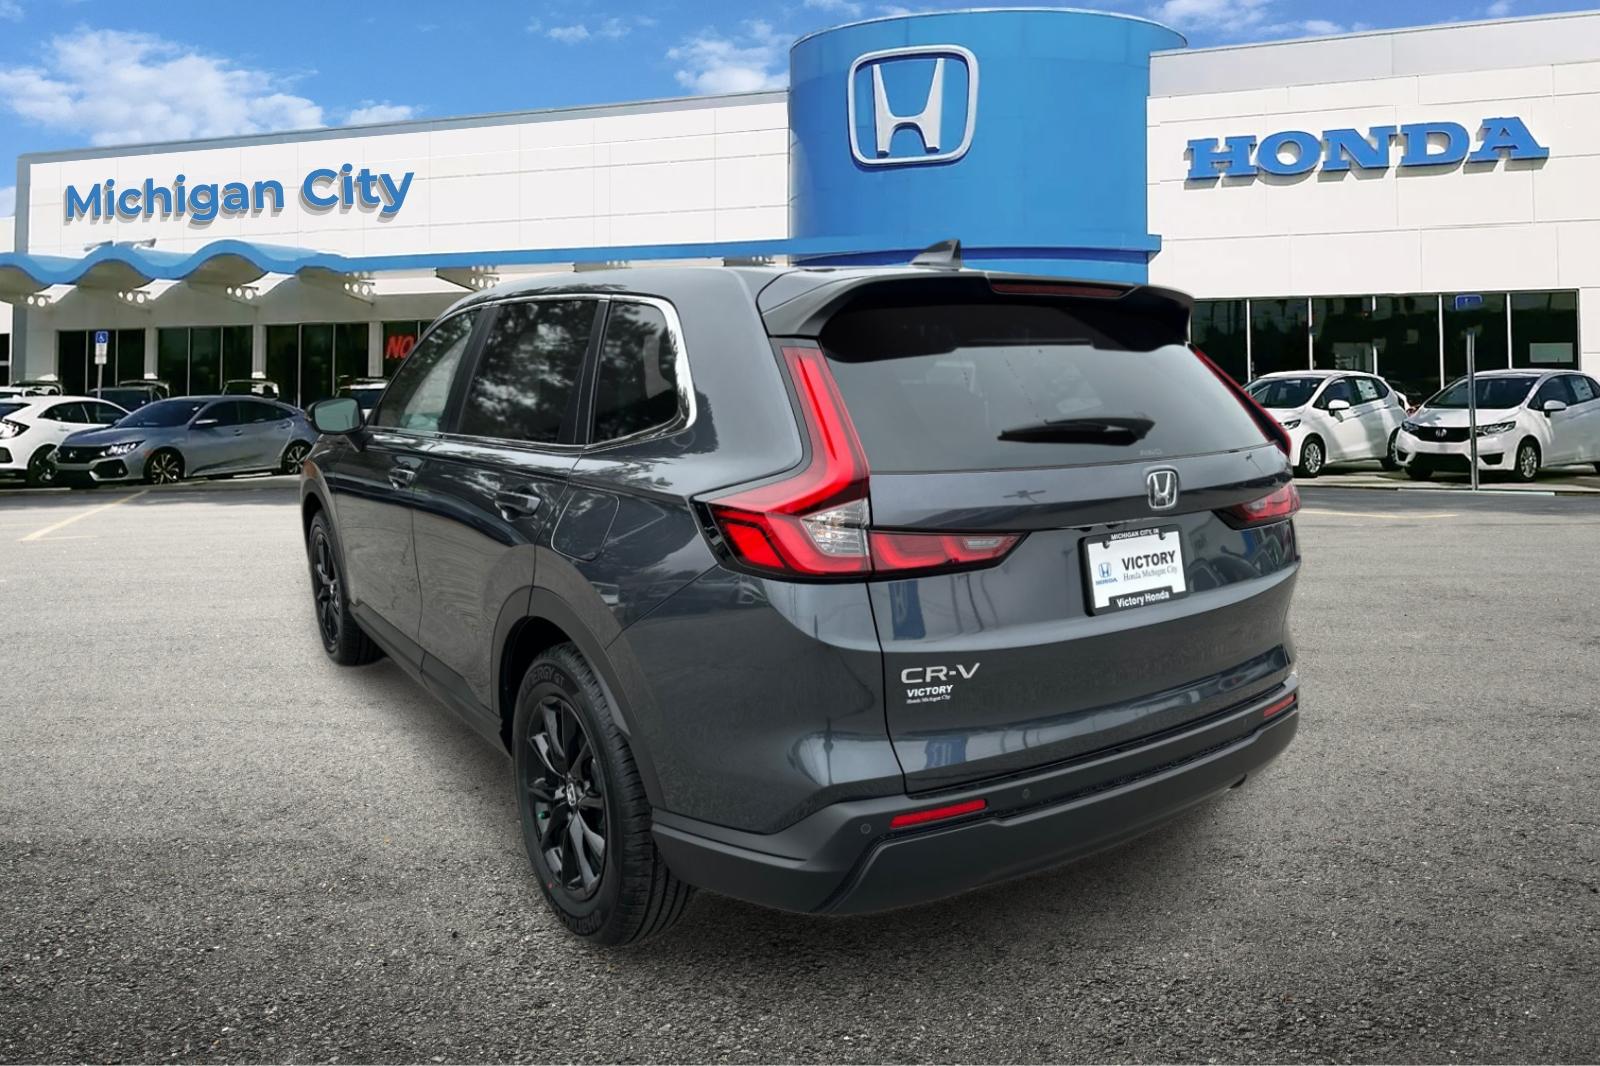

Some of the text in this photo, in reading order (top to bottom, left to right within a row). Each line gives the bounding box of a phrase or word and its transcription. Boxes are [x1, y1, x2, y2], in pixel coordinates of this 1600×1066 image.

[1186, 116, 1550, 183] HONDA
[65, 162, 415, 222] Michigan City
[1110, 531, 1139, 540] MICHIGAN
[1122, 550, 1176, 571] VICTORY
[1123, 571, 1142, 581] Honda
[1166, 564, 1178, 575] City
[1116, 589, 1170, 608] Victory Honda
[901, 662, 981, 684] CR-V
[906, 684, 954, 698] VICTORY
